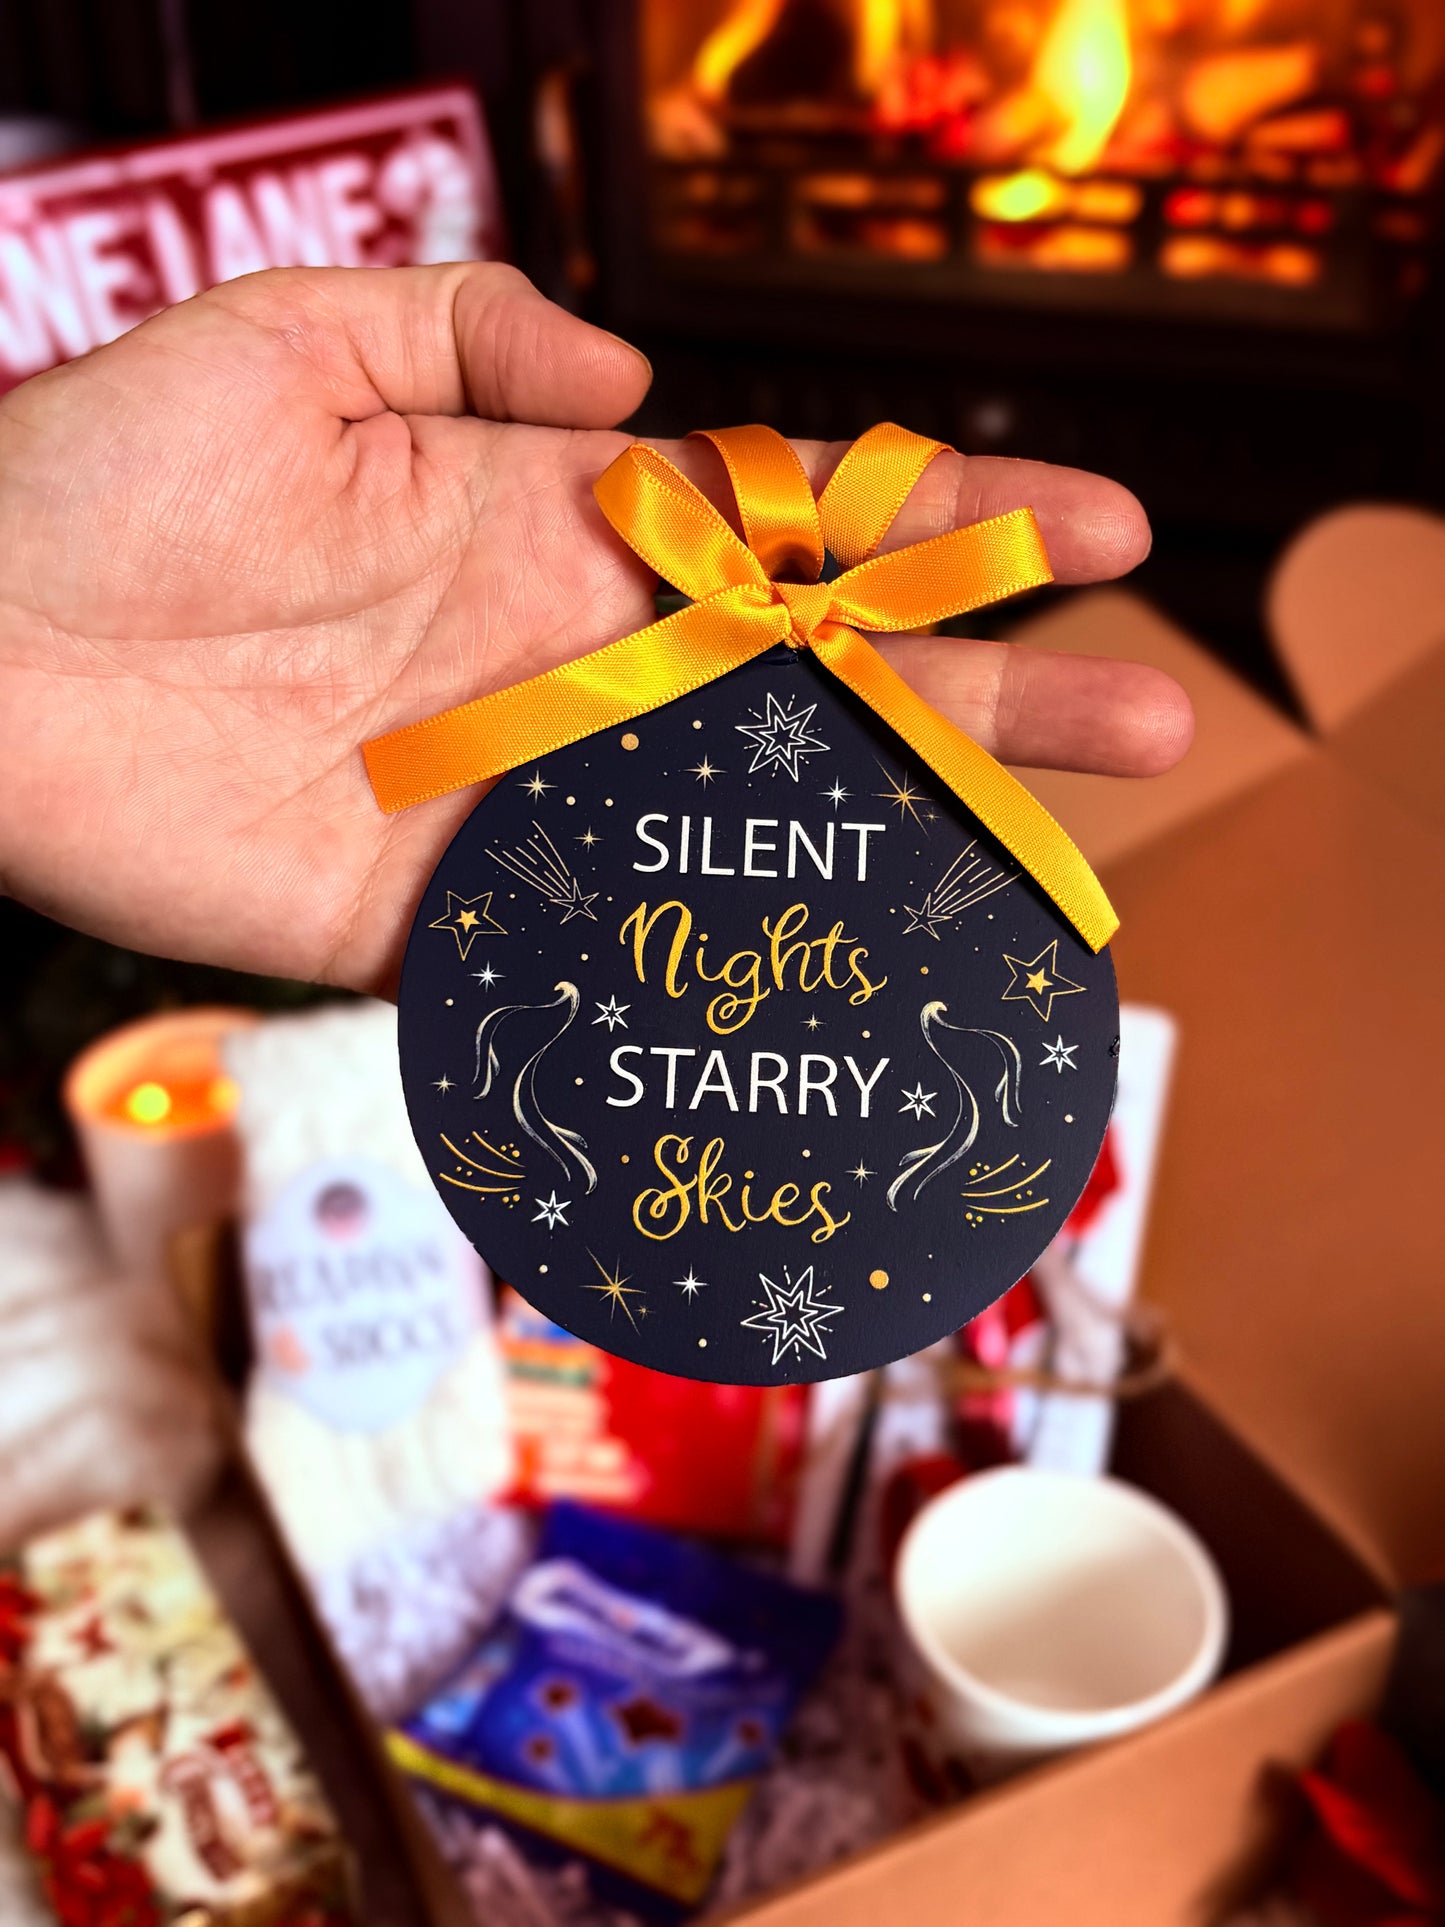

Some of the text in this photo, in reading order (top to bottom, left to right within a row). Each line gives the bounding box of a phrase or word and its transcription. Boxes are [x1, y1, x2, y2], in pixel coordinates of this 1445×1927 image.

[633, 814, 886, 881] SILENT
[620, 901, 887, 1034] Nights
[606, 1046, 890, 1118] STARRY
[633, 1134, 850, 1243] Skies
